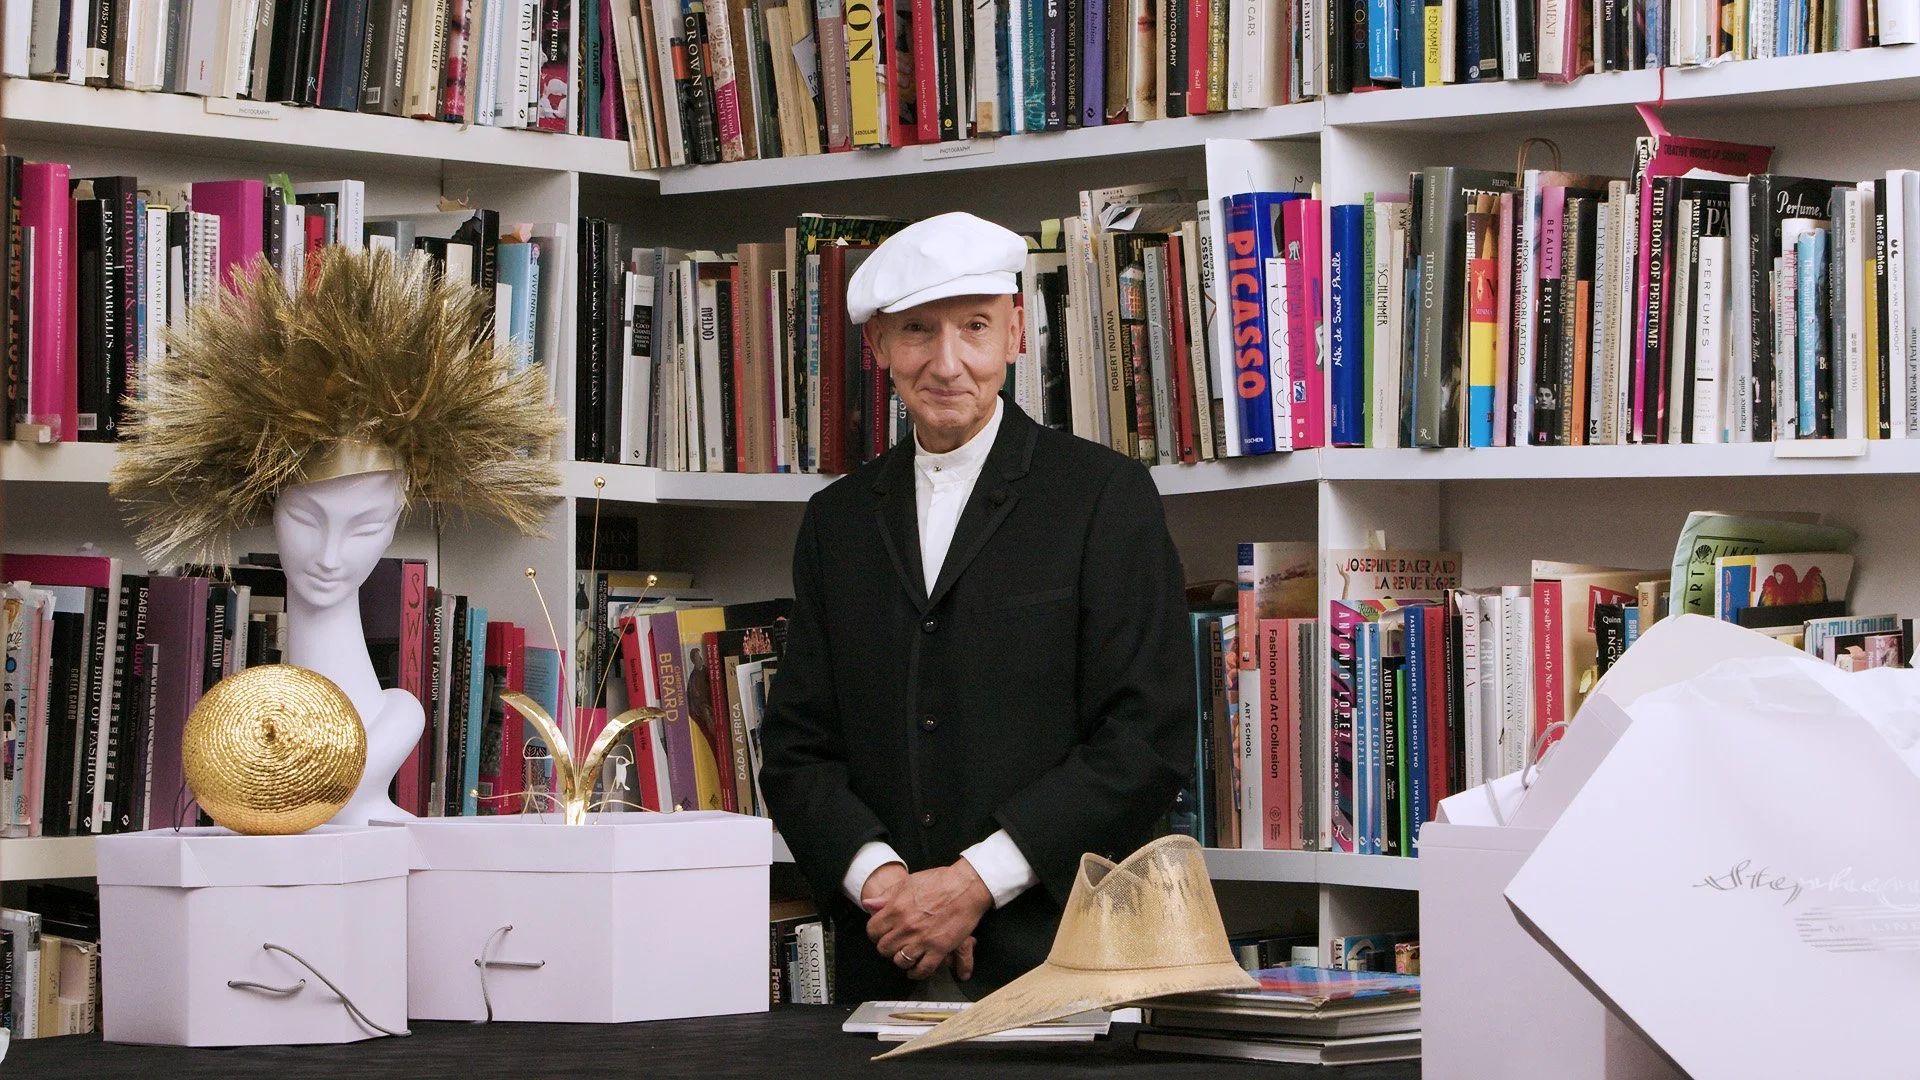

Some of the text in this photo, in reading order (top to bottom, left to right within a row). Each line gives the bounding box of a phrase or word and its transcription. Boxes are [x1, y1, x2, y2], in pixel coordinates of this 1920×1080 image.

[99, 1, 110, 44] 1935-1990
[399, 18, 407, 44] HIGH
[401, 5, 408, 16] IN
[442, 3, 450, 36] MICHAEL
[550, 10, 560, 61] PICTURES
[846, 3, 875, 64] ON
[1089, 9, 1098, 45] Fashion
[1169, 1, 1177, 67] PHOTOGRAPHY
[1247, 6, 1257, 37] CARS
[1353, 0, 1365, 49] COLOR
[1427, 15, 1438, 64] DUMMIES
[1605, 1, 1613, 21] Flora
[362, 22, 375, 92] Twelvetrees Press
[395, 45, 404, 88] FASHION
[431, 14, 443, 71] LEON TALLEY
[518, 3, 532, 94] ORY TELLER
[684, 16, 704, 99] CROWNS
[827, 22, 840, 117] VIVIENNE WESTWOOD
[1068, 11, 1077, 110] PORTRAIT PHOTOGRAPHERS
[1193, 69, 1201, 90] Steidl
[238, 107, 271, 116] PHOTOGRAPHY
[716, 89, 729, 140] COSTUME
[723, 88, 736, 135] Hollywood
[939, 145, 971, 154] PHOTOGRAPHY
[103, 210, 114, 242] ELSA
[273, 189, 281, 269] UNGARO
[1691, 198, 1700, 239] PARFUM
[1776, 190, 1822, 217] Perfume,
[10, 197, 23, 304] JEREMY
[124, 192, 137, 337] SCHIAPARELLI & THE
[137, 215, 147, 306] Elsa Schiaparelli
[1200, 236, 1212, 290] PICASSO
[1363, 197, 1375, 307] Niki de Saint Phalle
[1544, 219, 1555, 272] BEAUTY
[1647, 186, 1665, 350] THE BOOK OF PERFUME
[1876, 214, 1886, 277] Hair&Fashion
[104, 245, 115, 350] SCHIAPARELLI'S
[155, 246, 163, 324] SCHIAPARELLI
[530, 273, 538, 319] VIVIENNE
[1376, 269, 1389, 327] SCHLEMMER
[1423, 251, 1435, 309] TIEPOLO
[1518, 239, 1530, 365] MOKO MAORI TATTOO
[1558, 281, 1570, 315] beauty
[1593, 225, 1606, 358] TYRANNY BEAUTY
[1623, 256, 1632, 295] CATALOGUE
[1702, 257, 1713, 348] PERFUMES
[700, 307, 715, 342] COCTEAU
[809, 289, 819, 376] Max Ernst
[1146, 253, 1161, 362] CARL AND KARIN LARSSON
[1226, 229, 1267, 401] PICASSO
[1331, 252, 1345, 368] Niki de Saint Phalle
[1542, 286, 1552, 325] EXILE
[1800, 259, 1814, 403] The Beautiful People's Beauty Book
[8, 310, 21, 402] SCOTT
[862, 348, 872, 371] GABO
[1105, 310, 1120, 393] ROBERT INDIANA
[1120, 324, 1133, 389] HUNDERTWASSER
[1908, 327, 1918, 362] Perfume
[1737, 375, 1746, 433] Fragrance Guide
[1909, 375, 1917, 395] Book
[1909, 396, 1917, 418] H&R
[1909, 419, 1917, 434] The
[1345, 558, 1397, 573] JOSEPHINE
[1398, 559, 1431, 574] BAKER
[1374, 576, 1390, 590] LA
[1392, 576, 1424, 590] REVUE
[133, 586, 149, 677] ISABELLA BLOW
[1464, 607, 1478, 689] JOE EULA
[1602, 615, 1621, 624] Quinn
[1627, 619, 1637, 641] BORN
[431, 606, 443, 702] WOMEN OF FASHION
[629, 657, 639, 694] bauhaus
[1338, 612, 1350, 739] ANTONIO LOPEZ
[1480, 637, 1496, 691] GRUAU
[86, 620, 108, 796] RARE BIRD OF FASHION
[657, 652, 680, 723] BERARD
[675, 665, 684, 707] CHRISTIAN
[1268, 628, 1280, 780] Fashion and Art Collusion
[1357, 657, 1366, 768] ANTONIO'S PEOPLE
[1370, 657, 1380, 768] ANTONIO'S PEOPLE
[16, 694, 29, 773] ALGEBRA
[733, 702, 748, 781] DADA AFRICA
[1245, 722, 1254, 760] SCHOOL
[1384, 668, 1396, 768] AUBREY BEARDSLEY
[1409, 615, 1421, 834] FASHION DESIGNERS' SKETCHBOOKS TWO HYWEL DAVIES
[809, 942, 822, 1004] SCOTTISH
